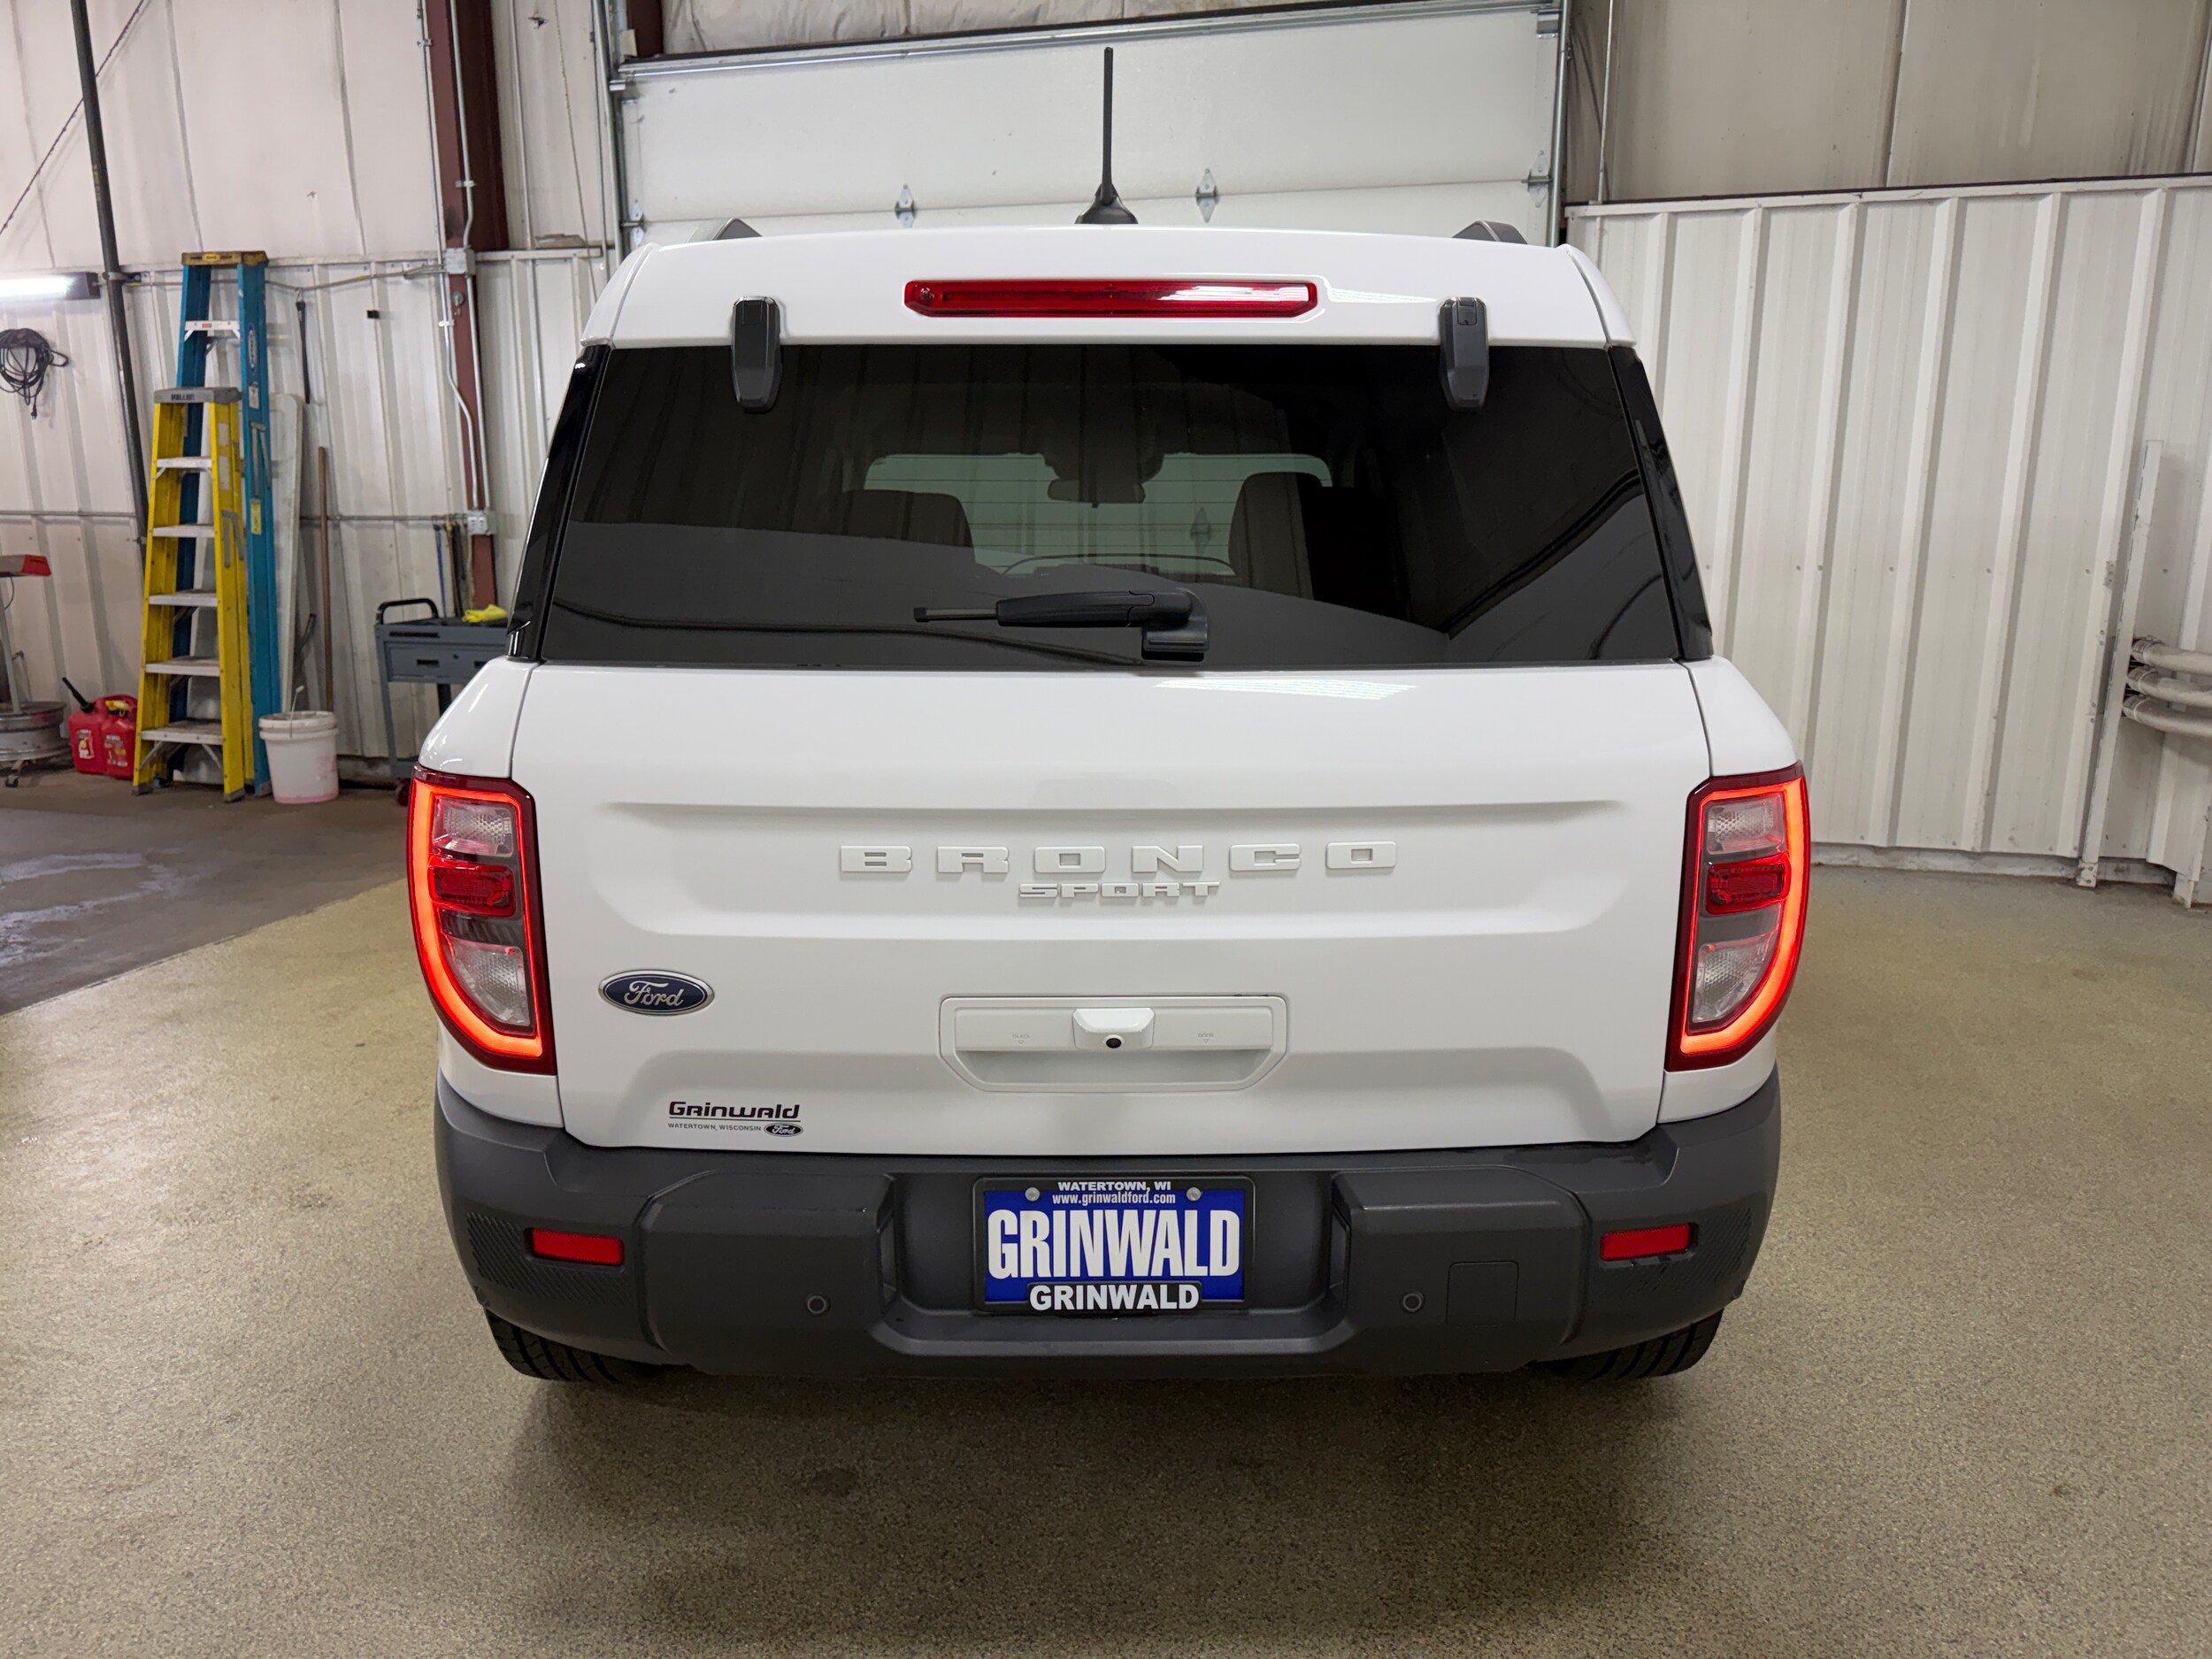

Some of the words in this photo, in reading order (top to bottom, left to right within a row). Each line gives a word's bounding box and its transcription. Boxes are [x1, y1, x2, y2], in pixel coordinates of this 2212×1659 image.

[840, 841, 1397, 874] BRONCO
[1018, 881, 1220, 899] SPORT
[624, 980, 684, 1007] Ford
[667, 1122, 718, 1131] WATERTOWN,
[772, 1125, 796, 1134] Ford
[1057, 1181, 1150, 1193] WATERTOWN,
[1153, 1181, 1171, 1191] WI
[1052, 1192, 1176, 1207] www.grinwaldford.com
[987, 1209, 1240, 1279] GRINWALD
[1029, 1284, 1200, 1311] GRINWALD
